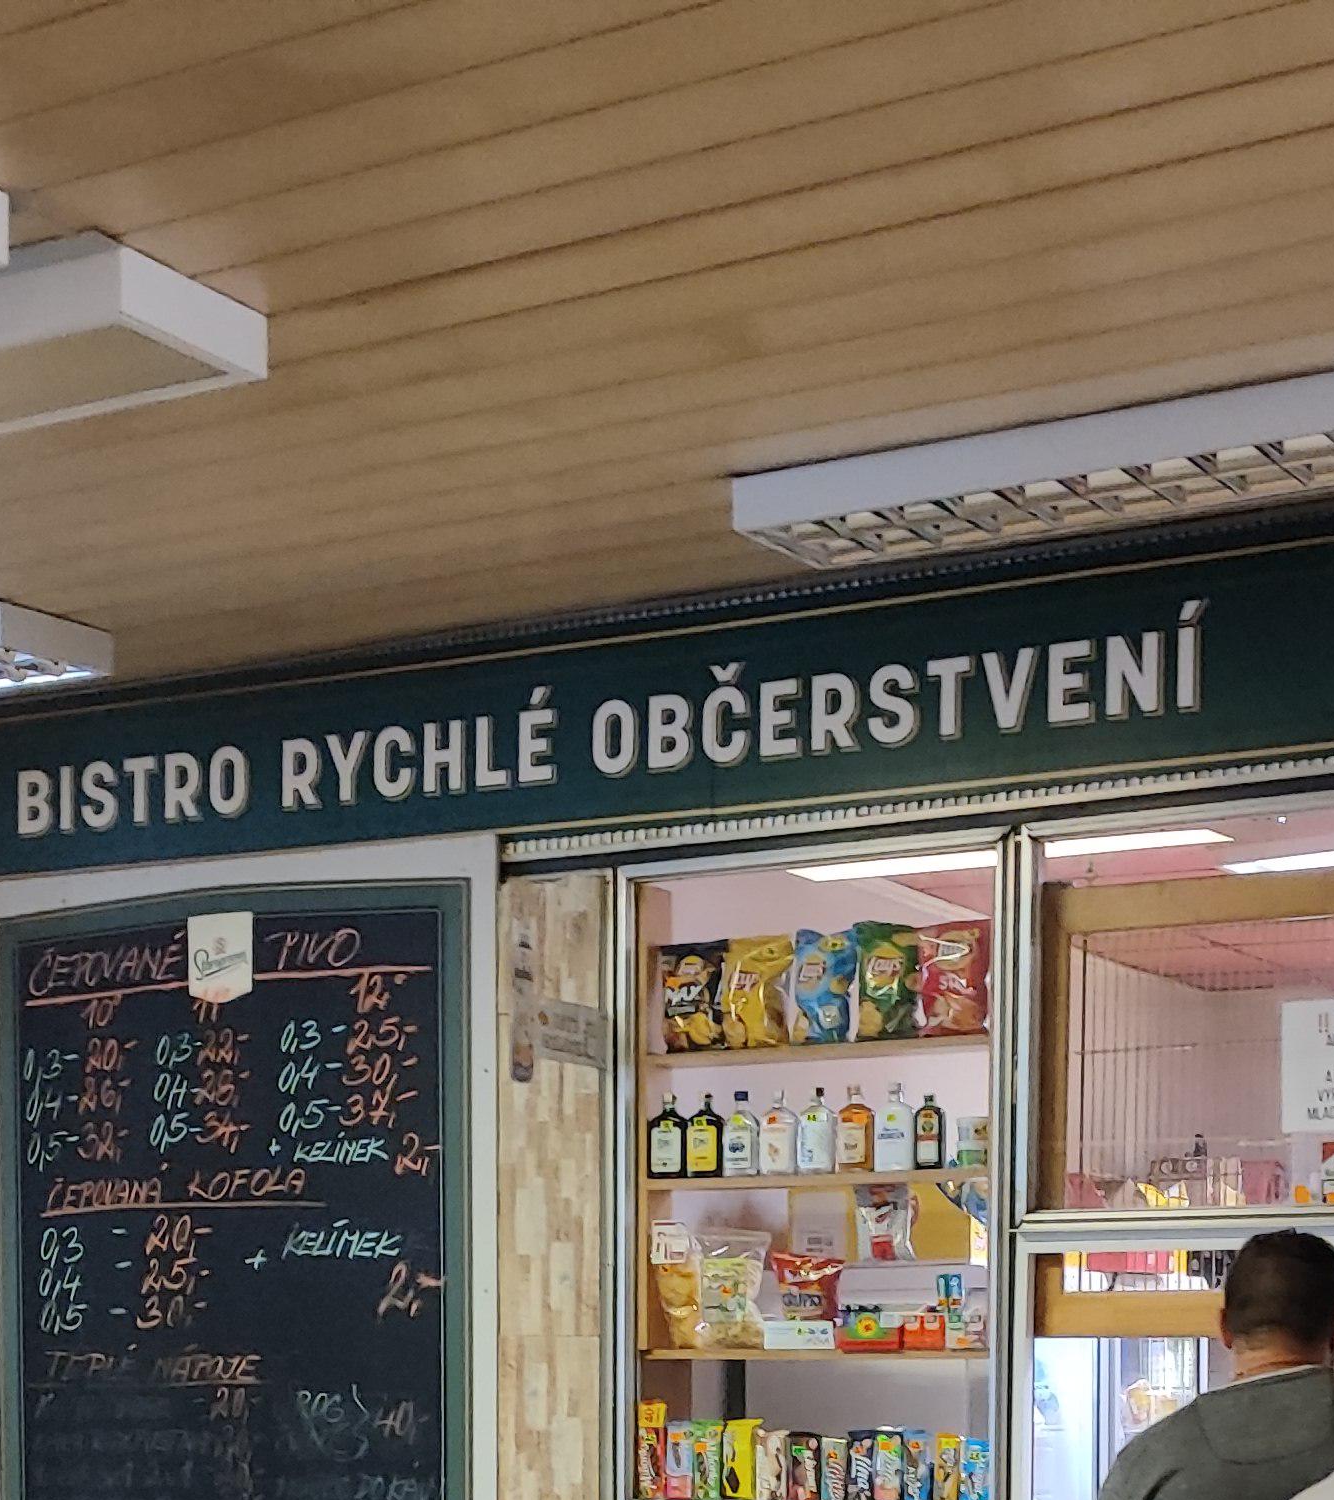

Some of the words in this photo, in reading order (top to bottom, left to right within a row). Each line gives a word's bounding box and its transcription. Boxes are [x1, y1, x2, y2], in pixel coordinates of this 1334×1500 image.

[17, 745, 247, 838] BISTRO
[282, 687, 559, 812] RYCHLÉ
[591, 599, 1210, 776] OBČERSTVENÍ
[28, 930, 188, 998] ČEPOVANÉ
[265, 928, 363, 972] PIVO
[292, 1131, 390, 1165] KELÍMEK
[187, 1166, 307, 1201] KOFOLA
[281, 1218, 403, 1261] KELÍMEK
